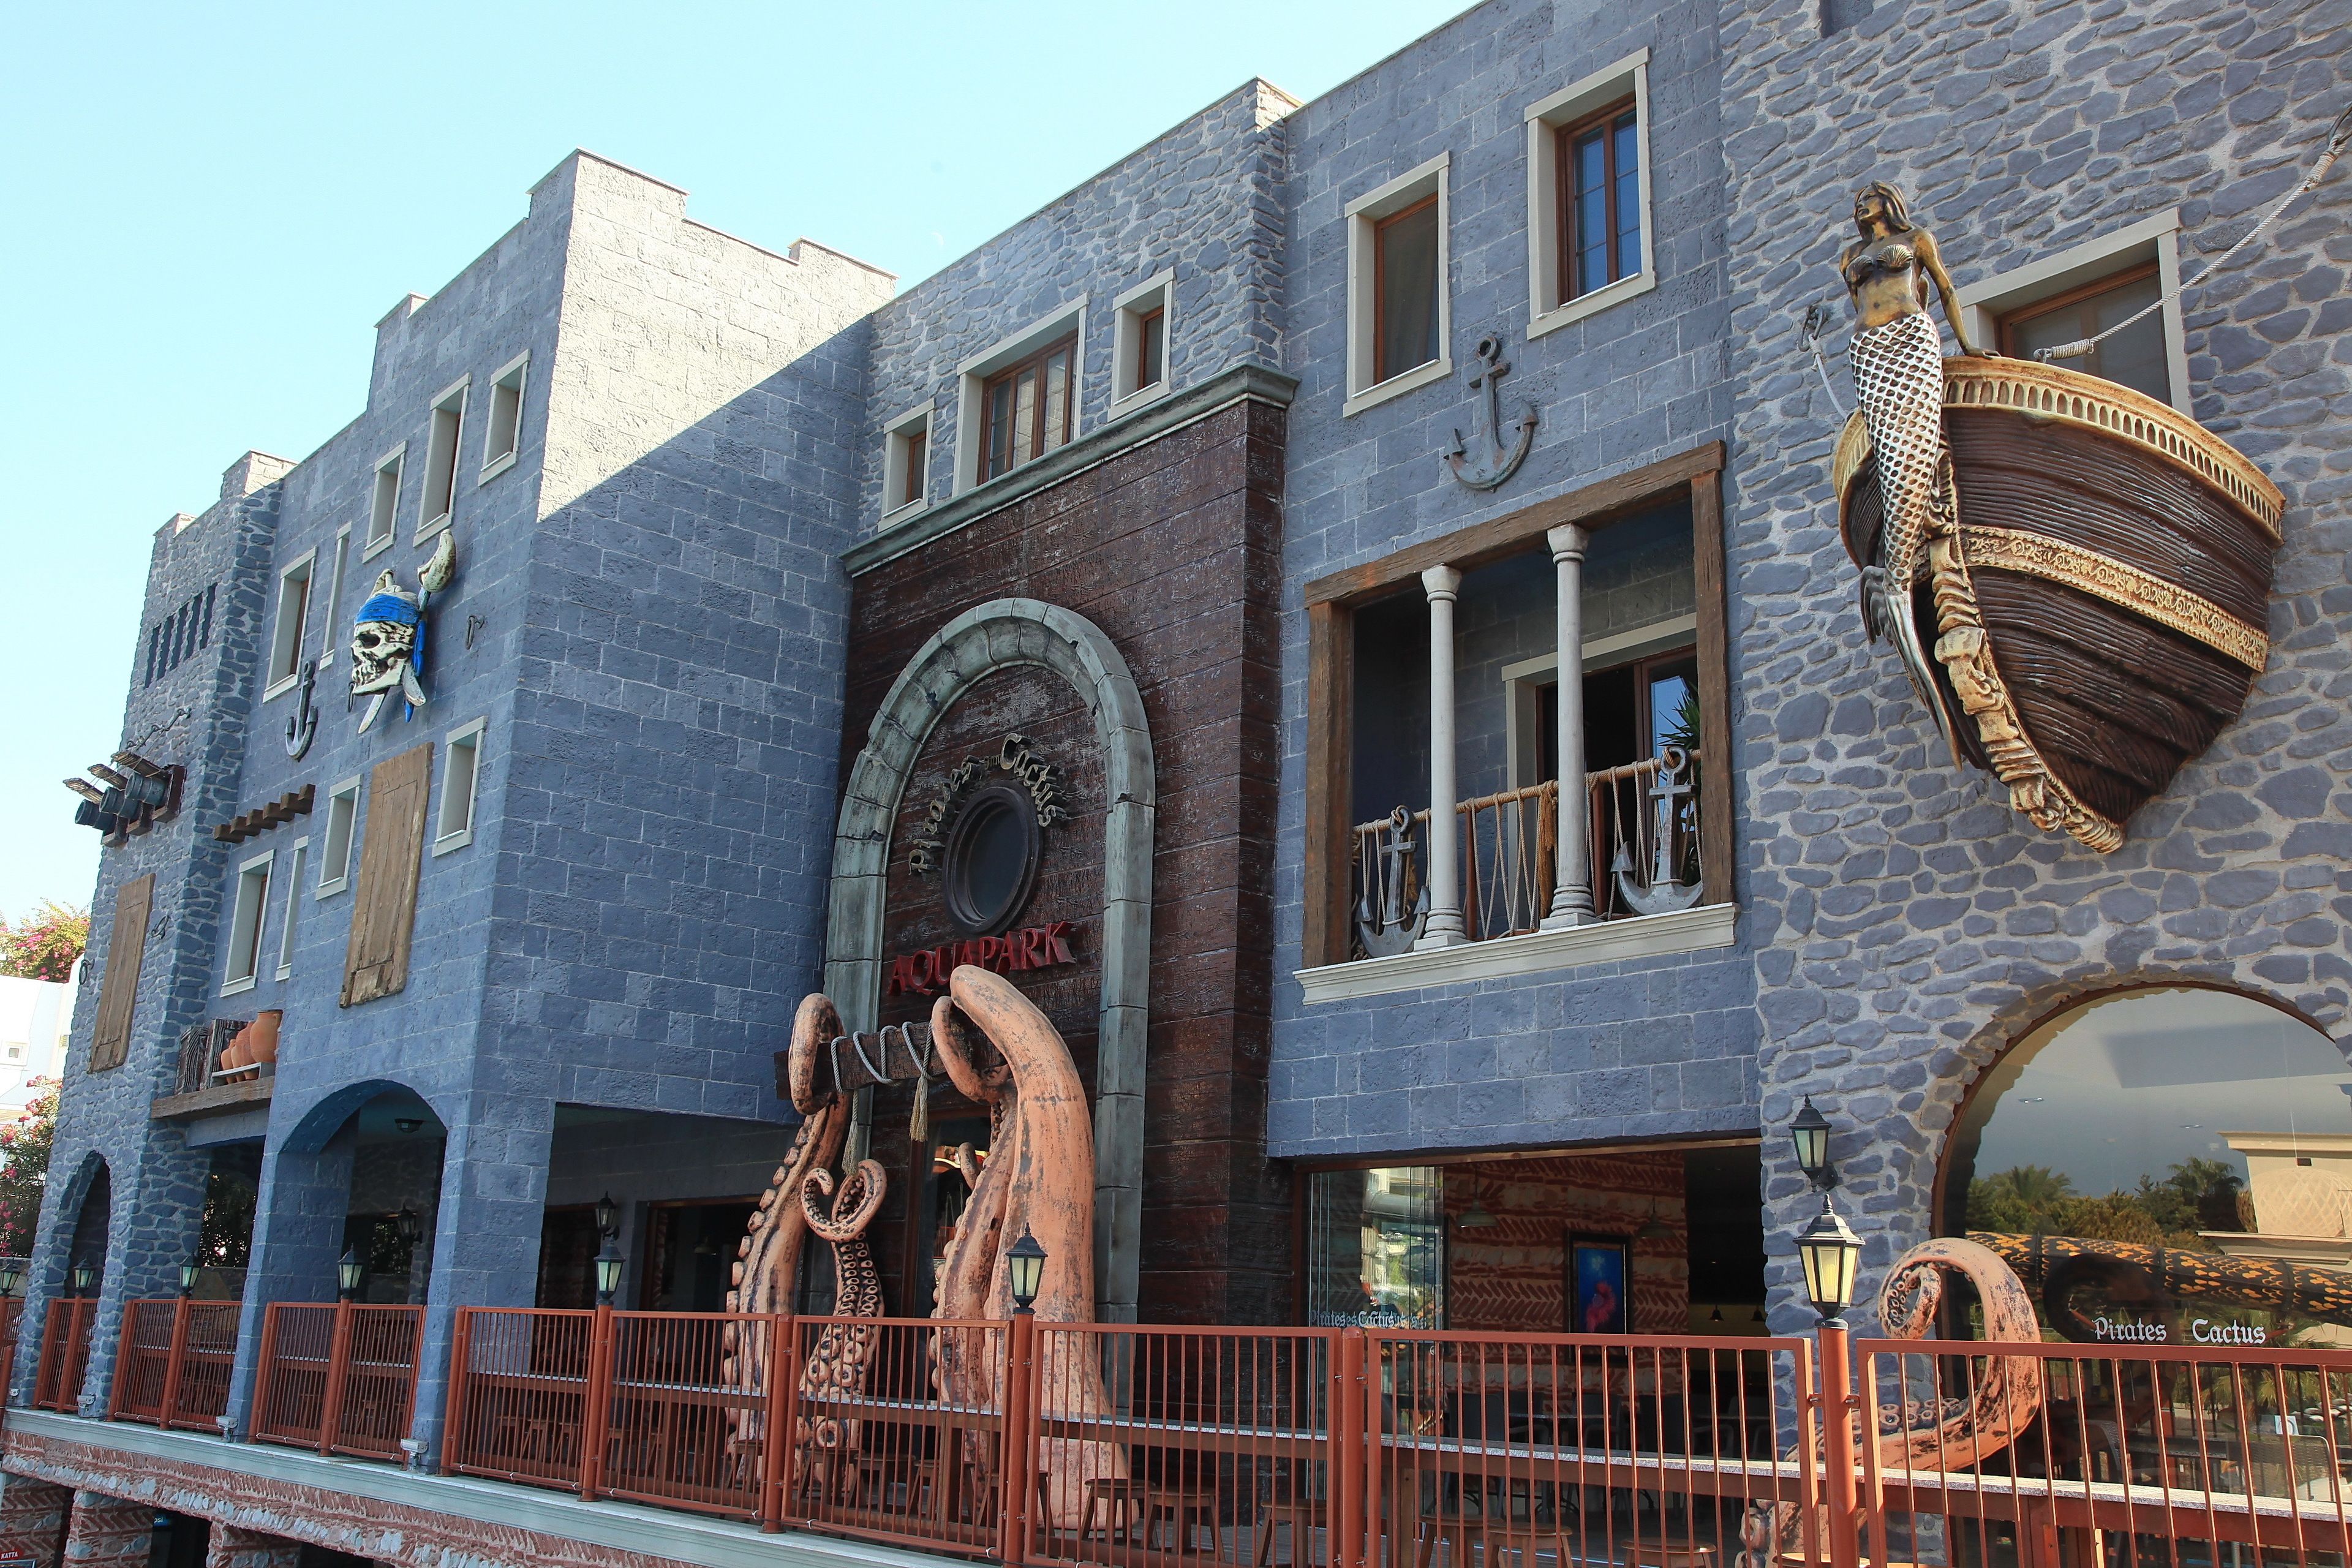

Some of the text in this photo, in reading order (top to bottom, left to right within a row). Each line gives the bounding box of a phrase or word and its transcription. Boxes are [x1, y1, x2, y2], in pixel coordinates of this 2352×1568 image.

[908, 754, 981, 875] Pirates
[1000, 733, 1061, 827] Cactus
[887, 921, 1076, 996] AQUAPARK
[1359, 1310, 1395, 1328] Cactus
[2092, 1317, 2266, 1344] Pirates Cactus
